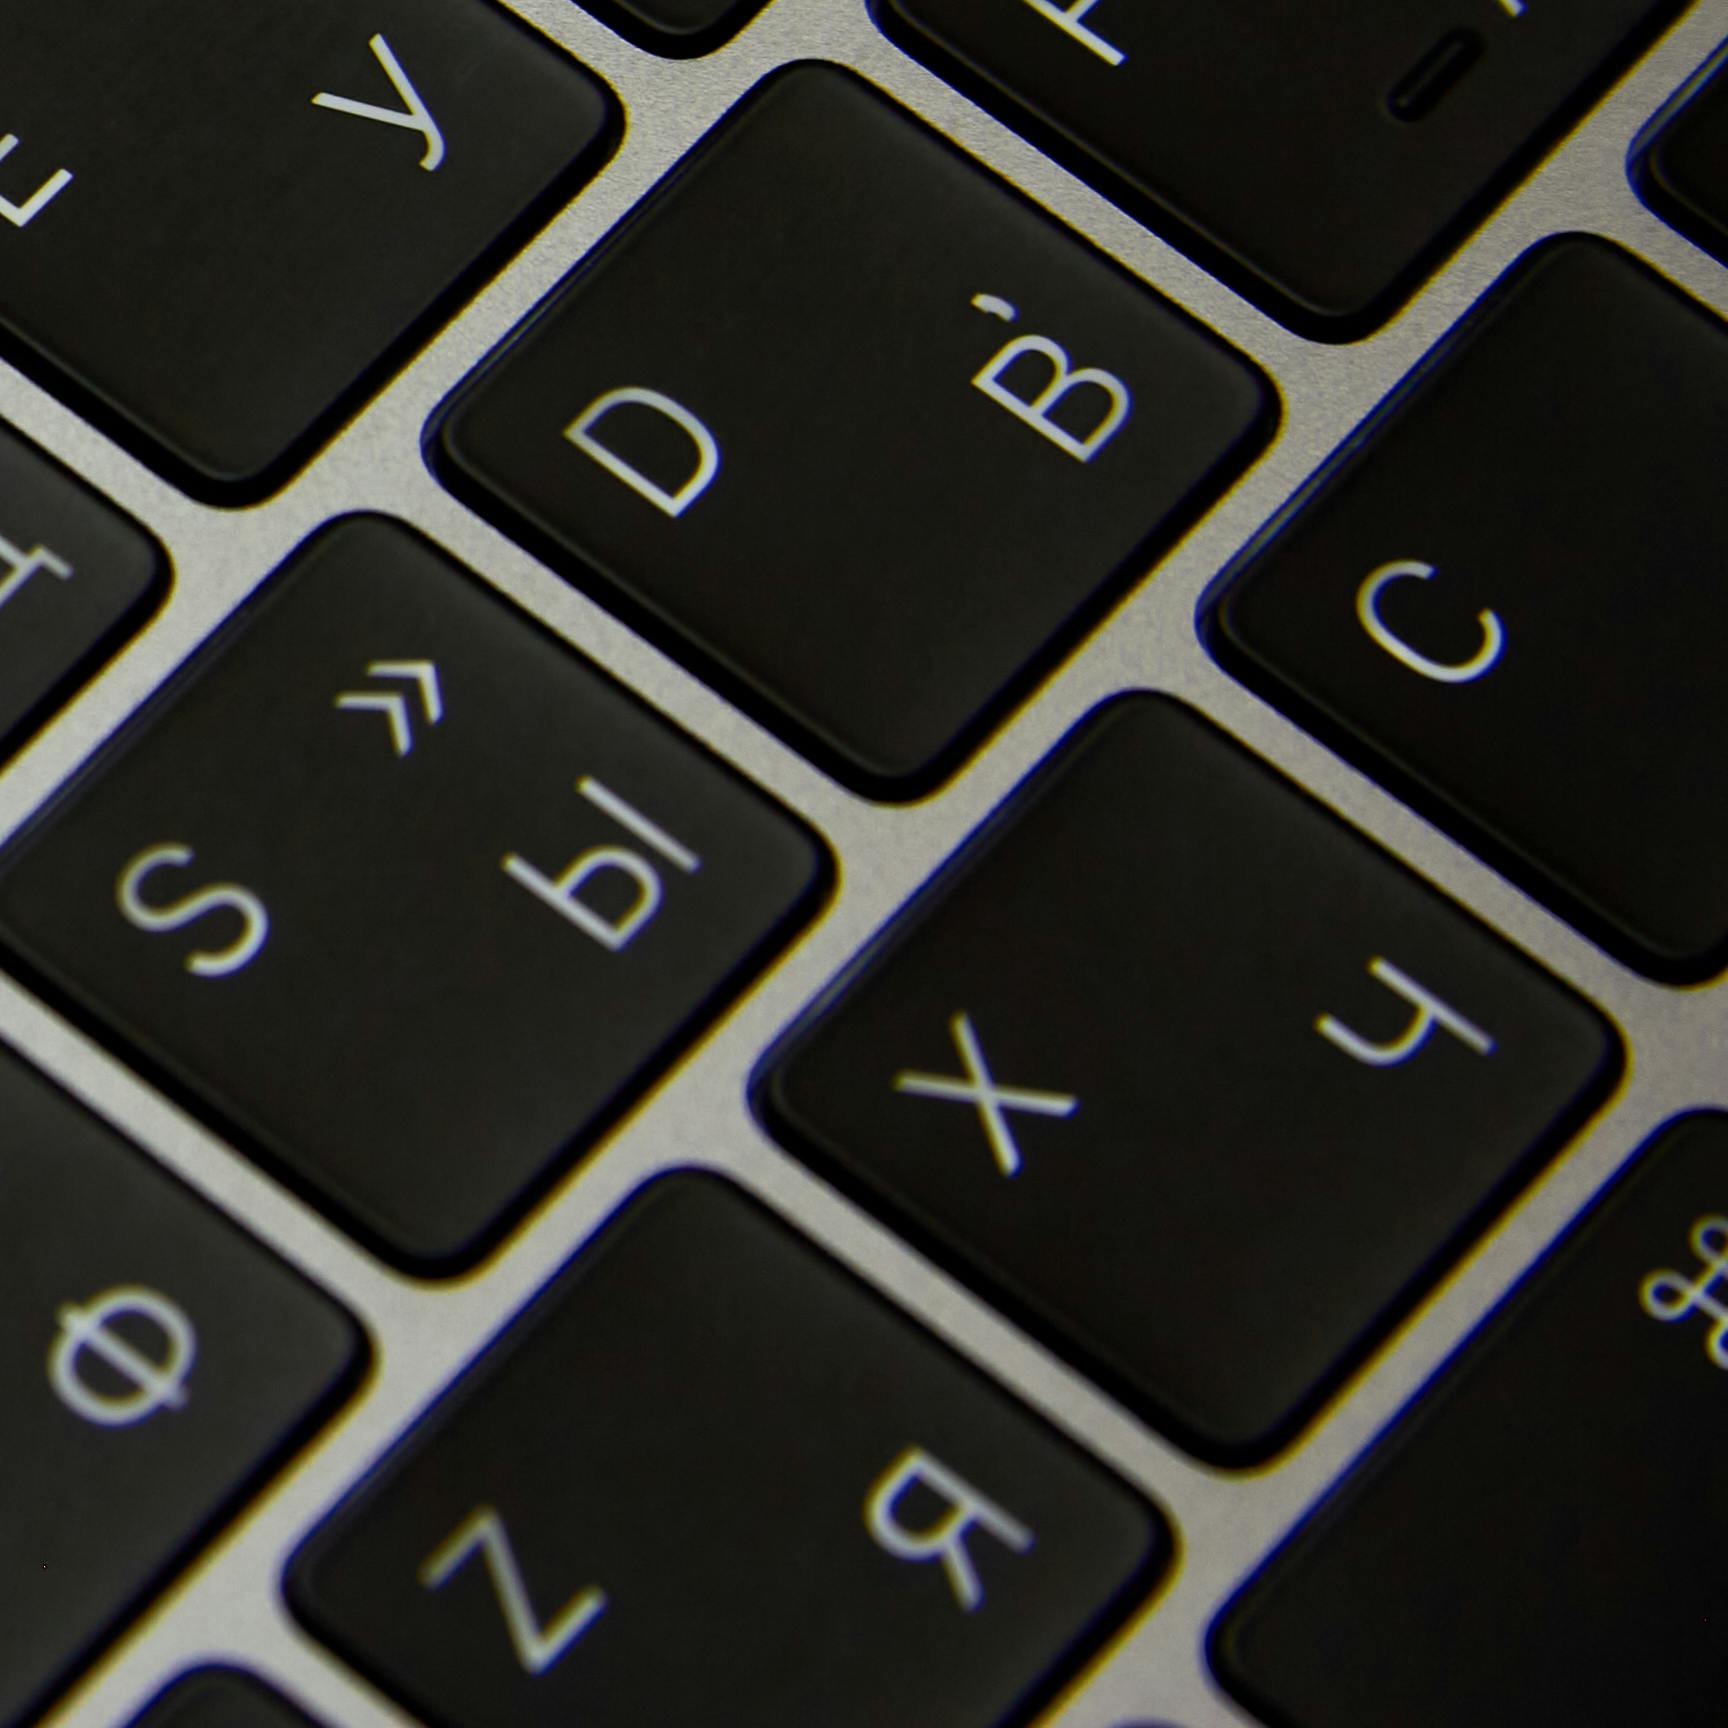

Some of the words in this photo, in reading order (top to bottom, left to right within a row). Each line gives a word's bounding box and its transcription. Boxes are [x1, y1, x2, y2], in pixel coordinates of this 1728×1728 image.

[311, 33, 448, 171] У
[565, 387, 722, 518] D
[1356, 560, 1508, 684] C
[119, 845, 270, 978] S
[503, 777, 701, 951] Ы
[1316, 958, 1497, 1067] Ч
[898, 1016, 1080, 1176] X
[50, 1288, 196, 1428] Ф
[428, 1513, 606, 1675] Z
[866, 1449, 1034, 1609] Я
